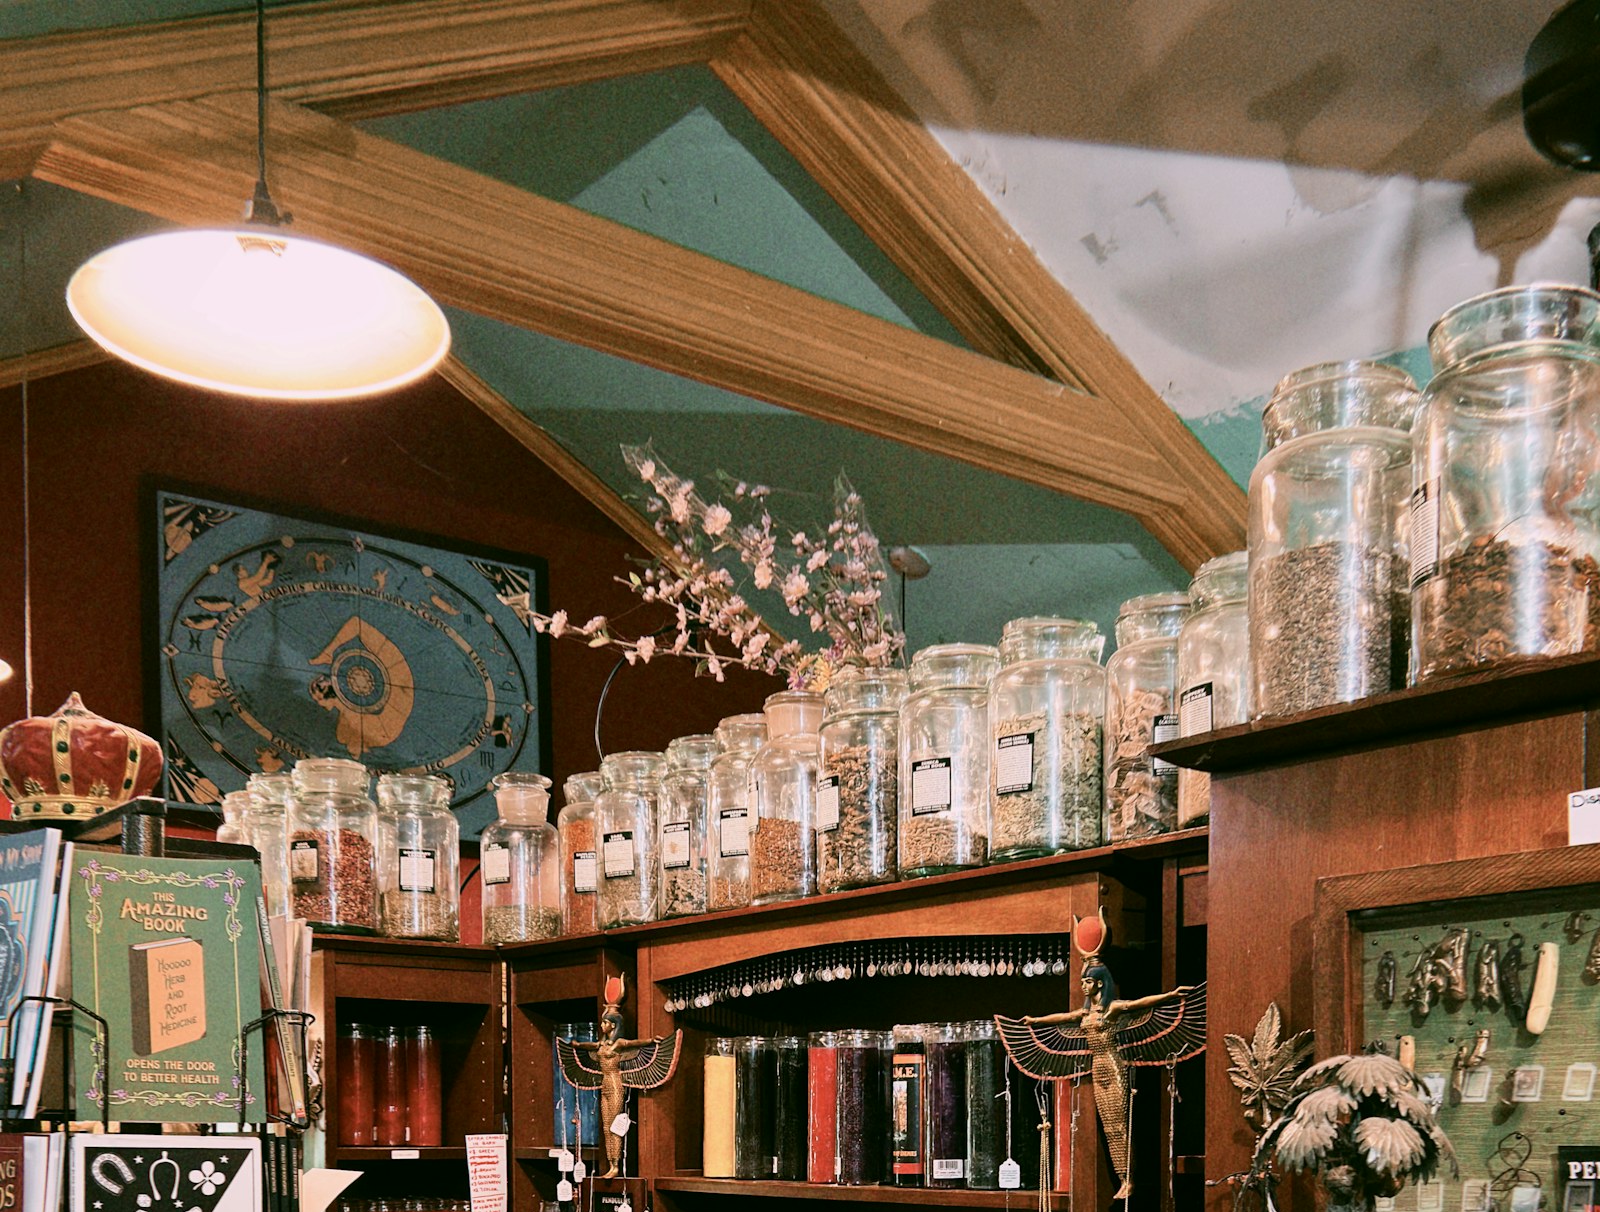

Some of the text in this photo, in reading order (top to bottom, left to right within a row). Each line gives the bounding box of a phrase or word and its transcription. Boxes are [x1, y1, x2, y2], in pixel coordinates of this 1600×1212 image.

[425, 761, 444, 772] LEO
[153, 891, 175, 902] THIS
[120, 898, 208, 922] AMAZING
[143, 917, 185, 932] BOOK
[126, 1058, 215, 1071] OPENS THE DOOR
[124, 1071, 220, 1085] TO BETTER HEALTH
